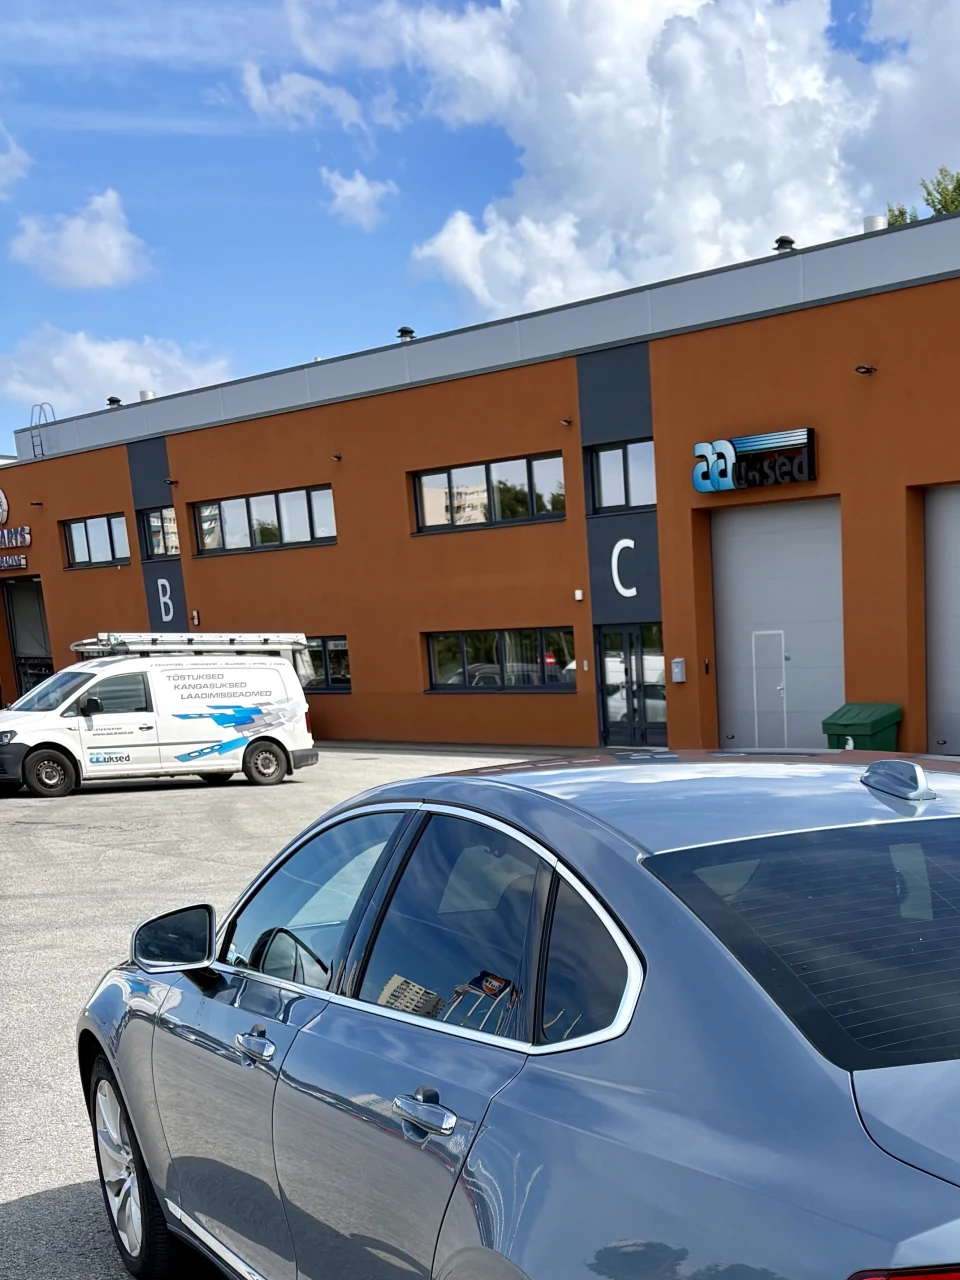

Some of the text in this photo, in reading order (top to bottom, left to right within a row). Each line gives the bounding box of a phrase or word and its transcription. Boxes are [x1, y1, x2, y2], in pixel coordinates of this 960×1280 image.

[611, 538, 637, 597] C
[157, 579, 174, 622] B
[174, 682, 247, 690] KANGASUKSED
[180, 691, 272, 700] LAADIMISSEADMED
